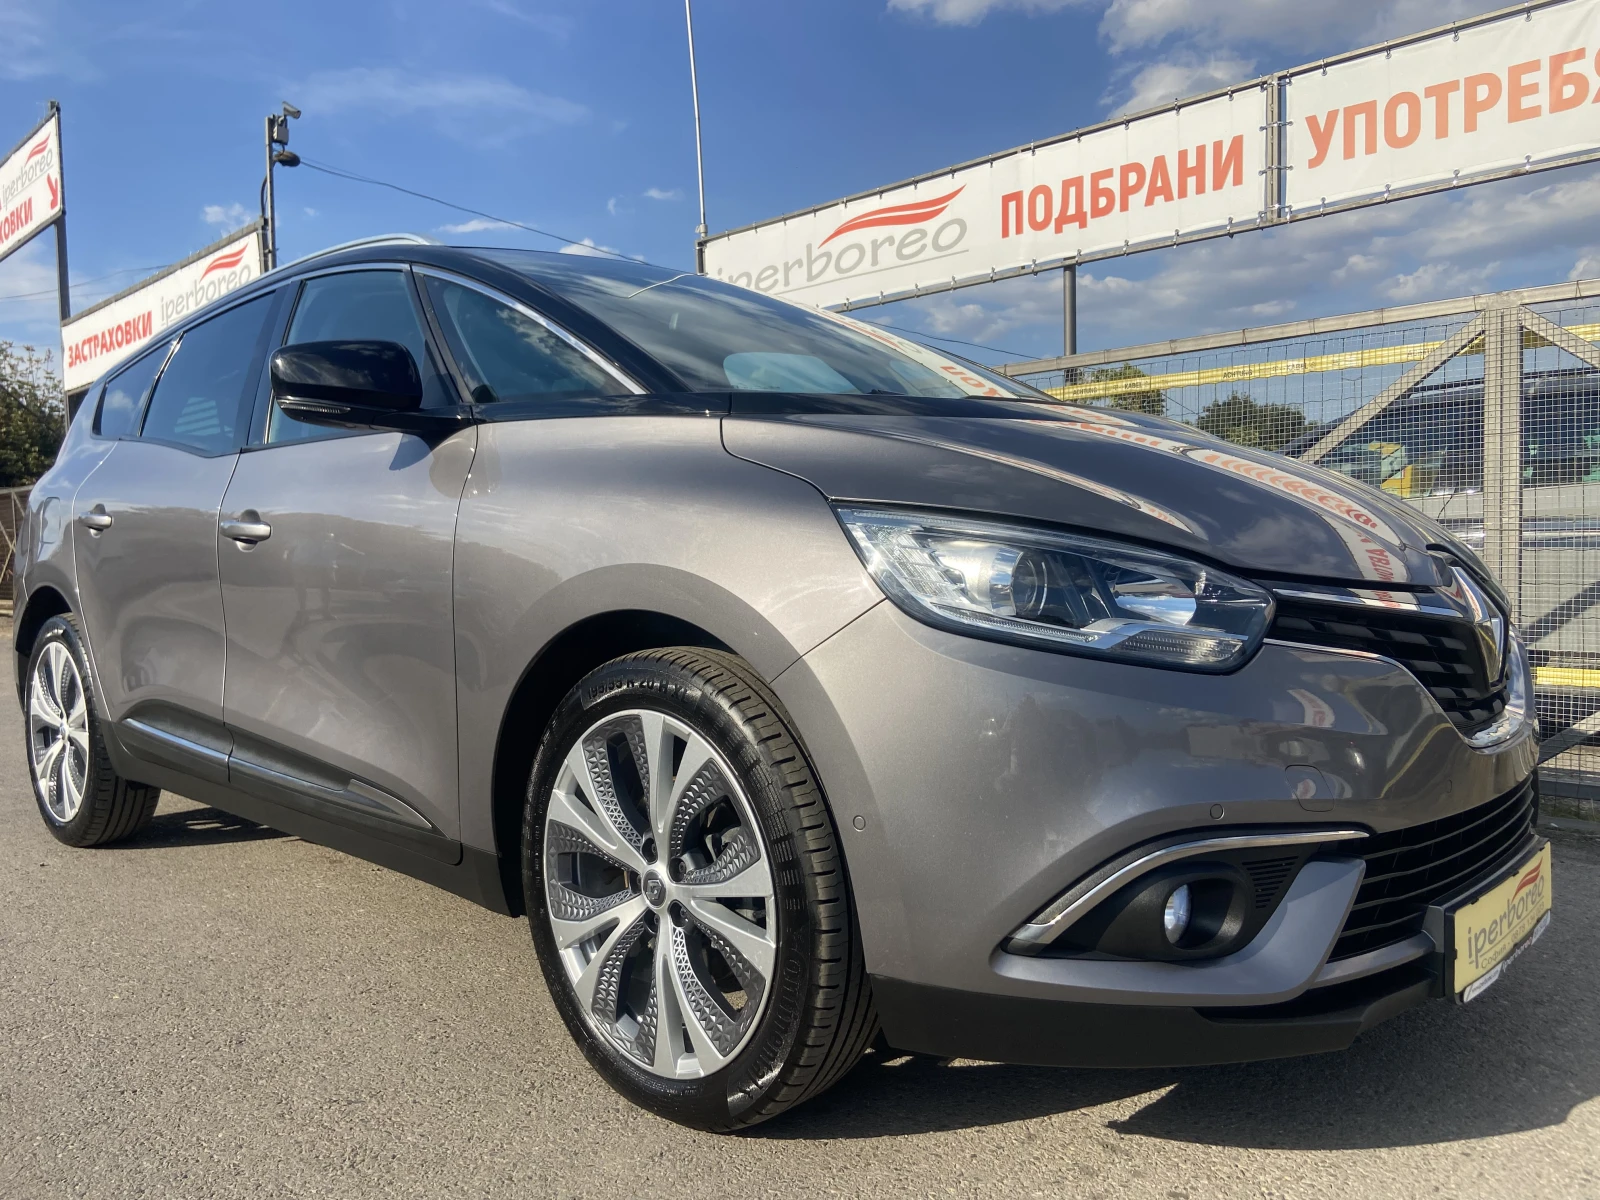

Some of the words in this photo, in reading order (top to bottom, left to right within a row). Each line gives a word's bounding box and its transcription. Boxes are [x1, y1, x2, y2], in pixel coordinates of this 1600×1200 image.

[1001, 134, 1244, 239] ПОДБРАНИ
[1304, 47, 1600, 170] УПОТРЕБ
[2, 148, 53, 211] iperboreo
[160, 263, 251, 328] iperboreo
[68, 310, 153, 369] ЗАСТРАХОВКИ
[1468, 874, 1545, 969] iperboreo
